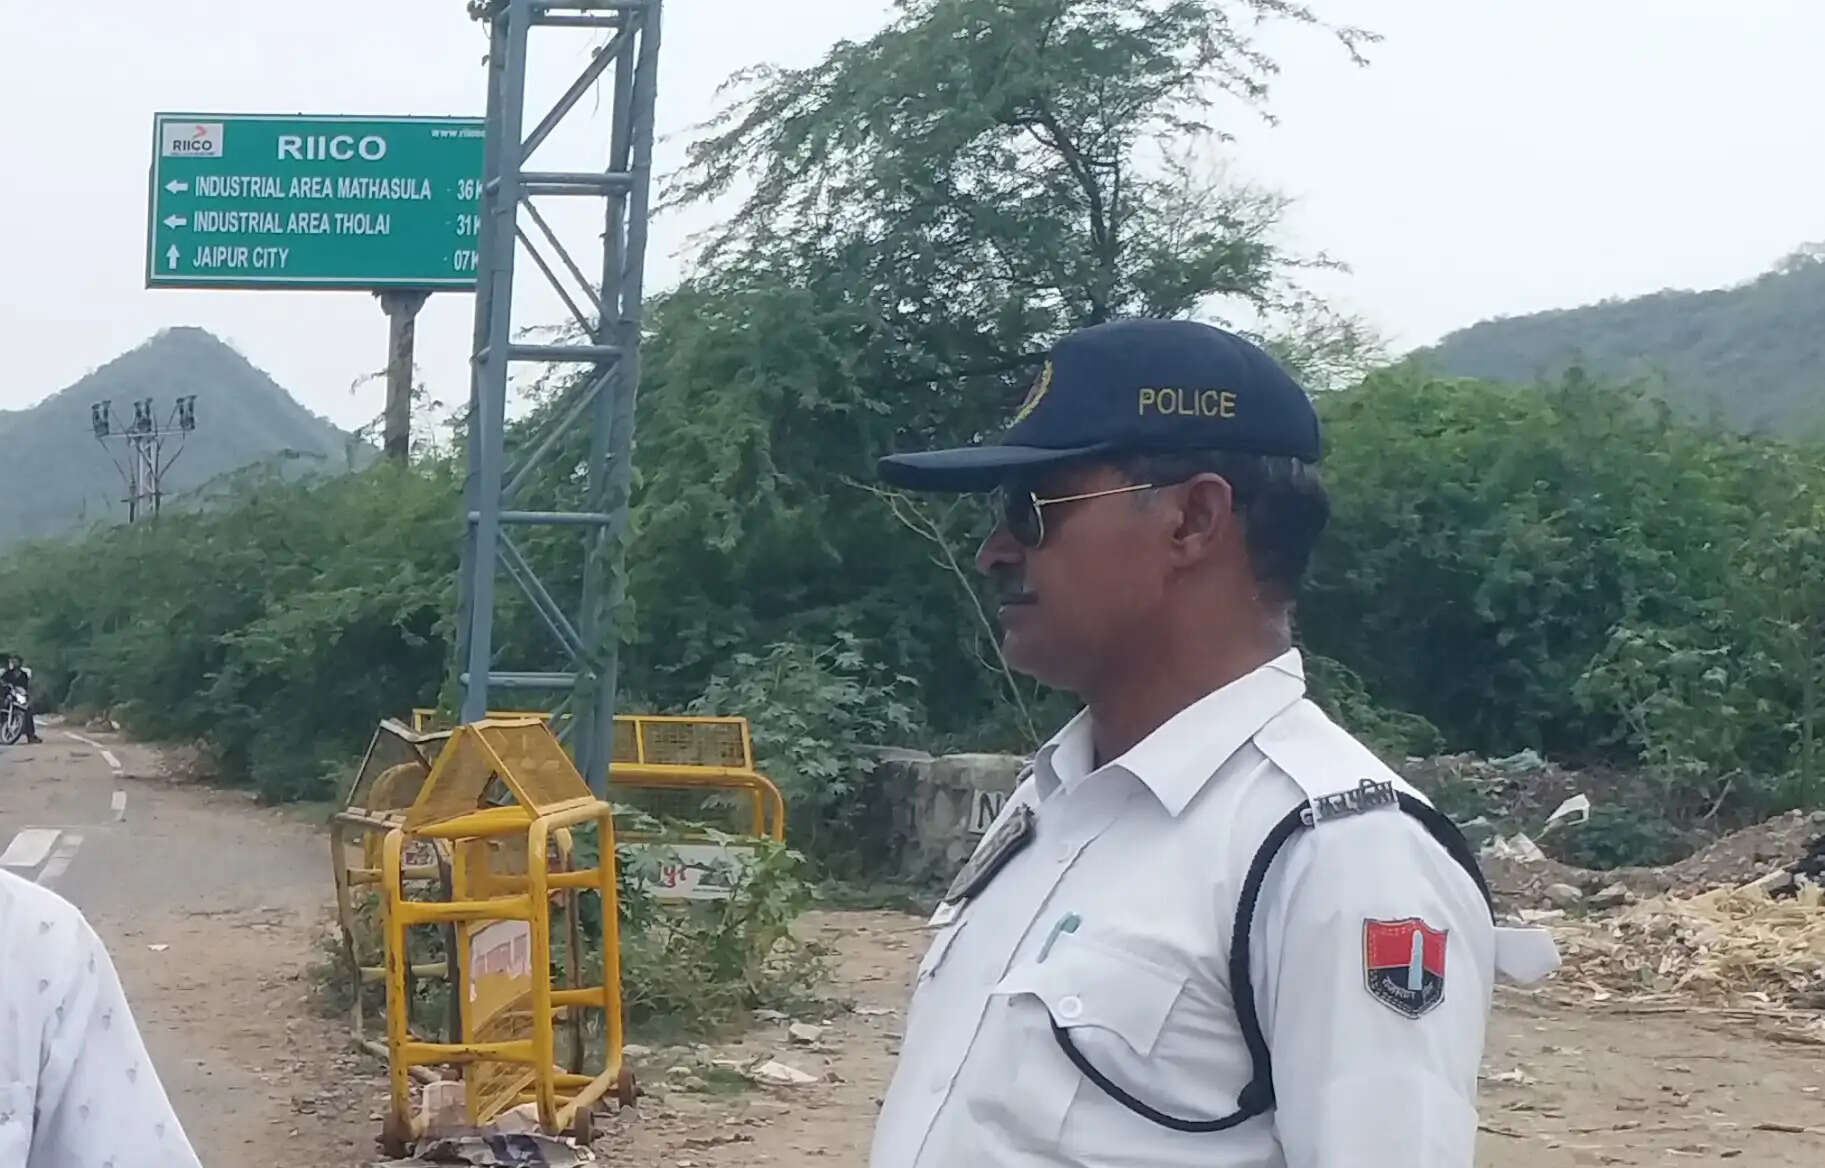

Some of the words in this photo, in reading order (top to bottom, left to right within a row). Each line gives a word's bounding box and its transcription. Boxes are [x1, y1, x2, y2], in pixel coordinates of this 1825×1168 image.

[173, 140, 213, 151] RIICO
[277, 135, 387, 161] RIICO
[195, 175, 285, 198] INDUSTRIAL
[288, 177, 334, 198] AREA
[337, 177, 432, 200] MATHASULA
[193, 211, 284, 234] INDUSTRIAL
[287, 213, 331, 235] AREA
[334, 213, 391, 235] THOLAI
[193, 246, 249, 268] JAIPUR
[252, 248, 289, 269] CITY
[1139, 388, 1237, 418] POLICE
